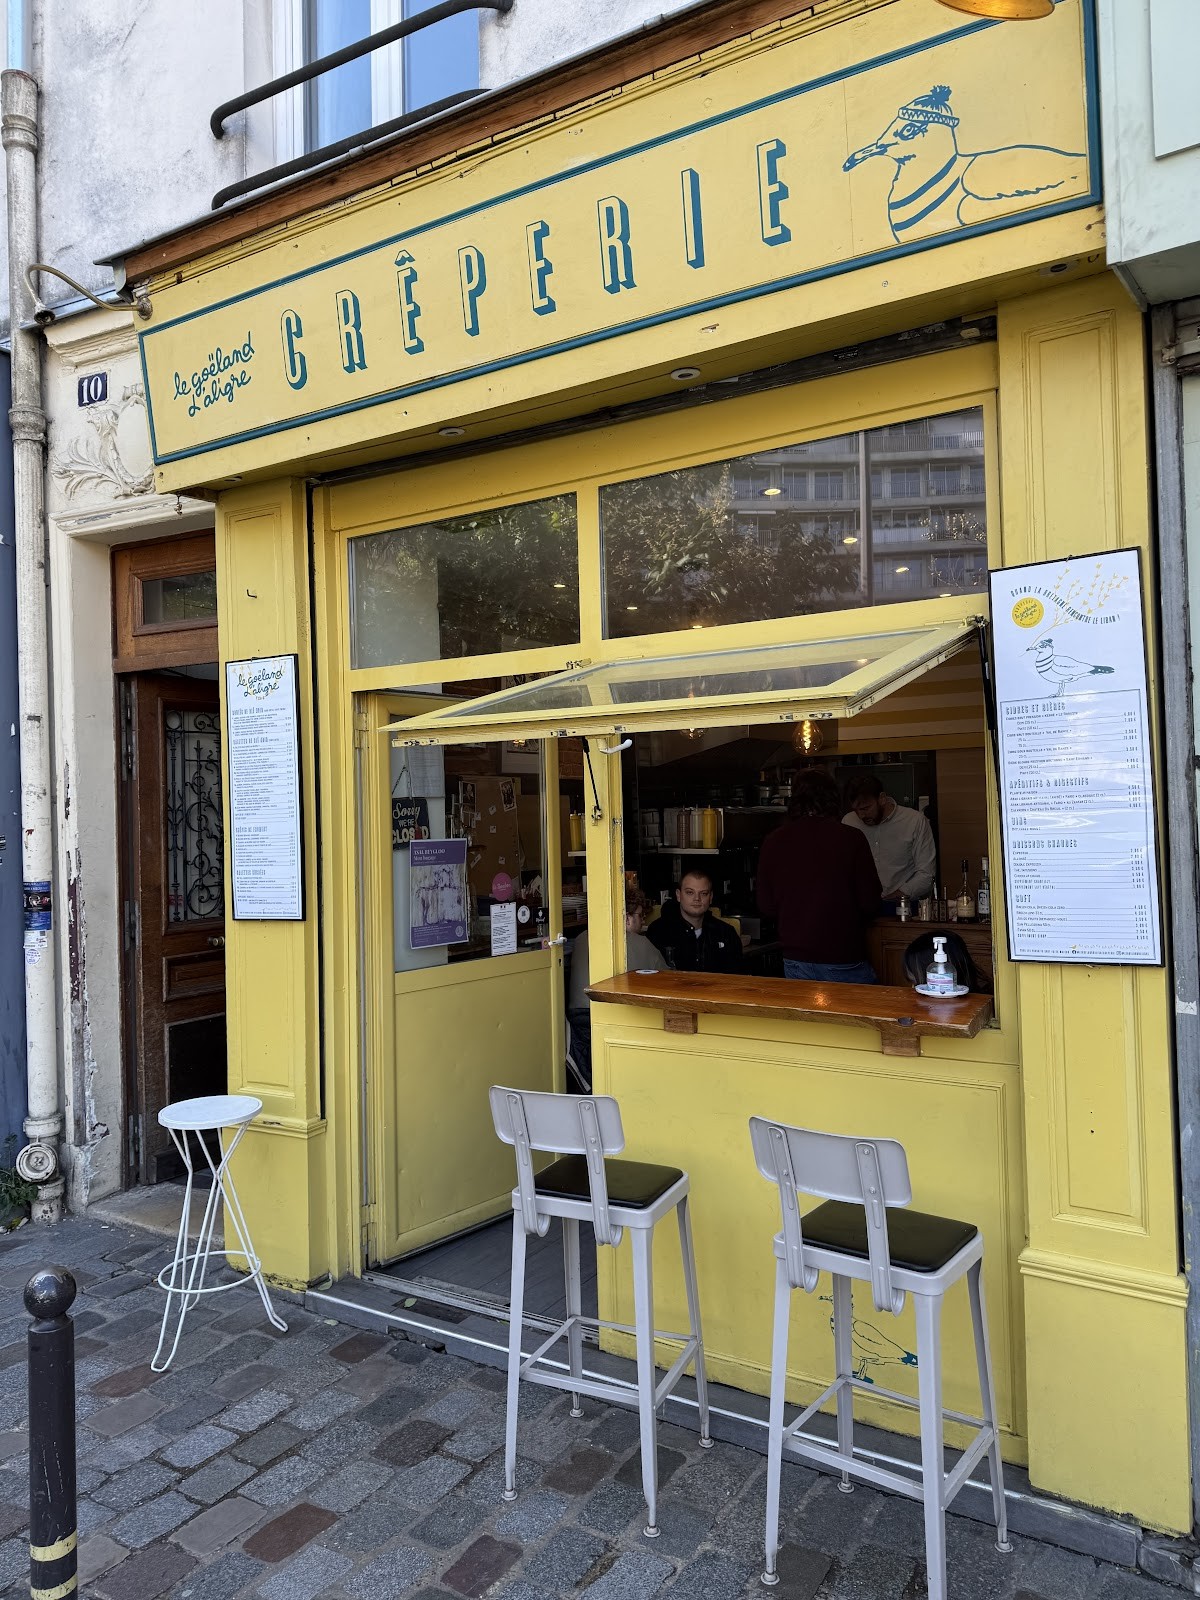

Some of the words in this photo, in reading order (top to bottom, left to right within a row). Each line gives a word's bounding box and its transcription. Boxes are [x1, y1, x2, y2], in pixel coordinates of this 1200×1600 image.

[280, 138, 792, 391] CRÊPERIE
[173, 371, 191, 401] le
[191, 330, 256, 398] goëland
[81, 375, 103, 405] 10
[393, 802, 421, 819] Sorry
[392, 826, 429, 845] CLOSD
